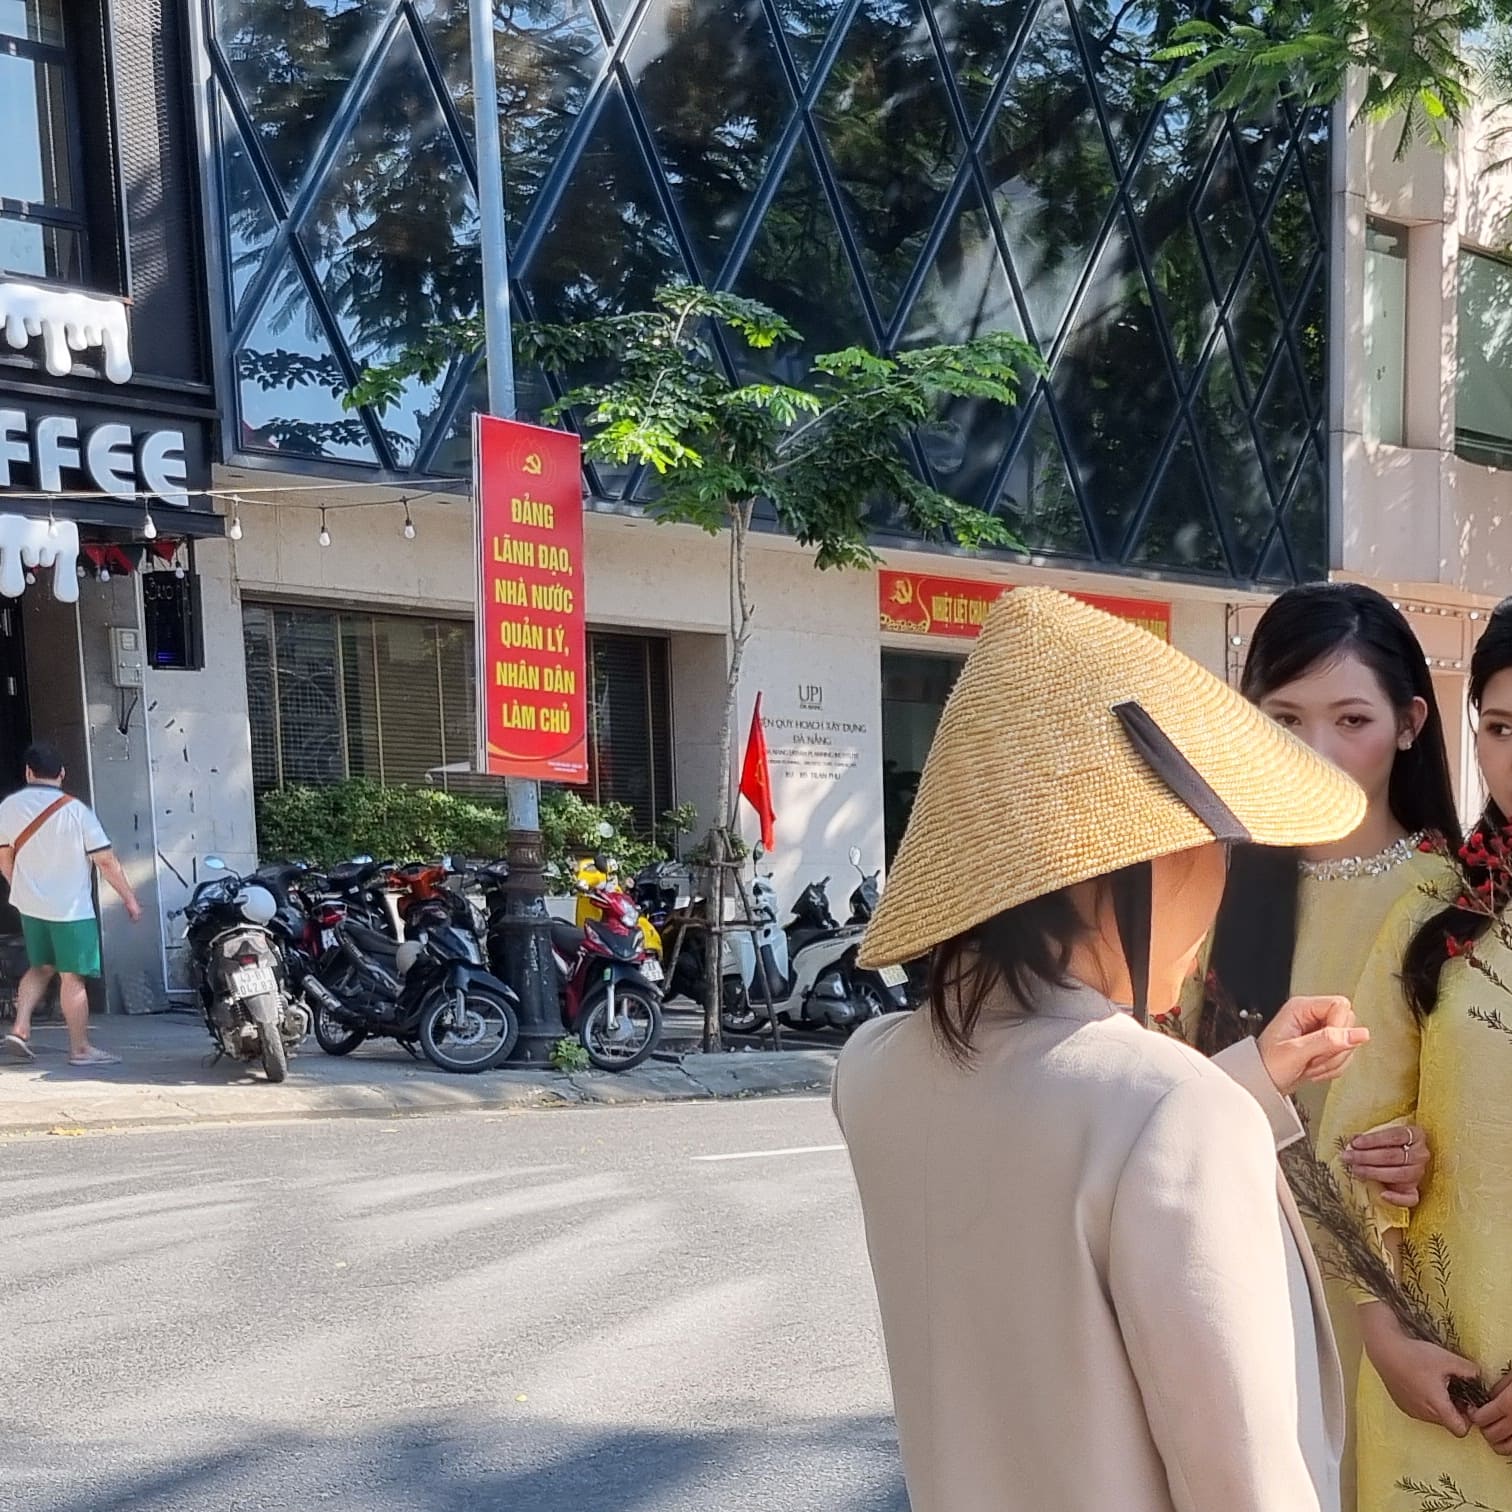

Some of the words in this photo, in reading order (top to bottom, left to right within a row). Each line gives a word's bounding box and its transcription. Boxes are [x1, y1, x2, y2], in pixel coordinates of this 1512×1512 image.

[511, 492, 554, 529] ĐẢNG
[493, 533, 535, 568] LÃNH
[538, 543, 573, 577] ĐẠO,
[495, 577, 529, 608] NHÀ
[531, 583, 574, 614] NƯỚC
[500, 616, 544, 650] QUẢN
[547, 624, 570, 657] LÝ,
[496, 660, 540, 691] NHÂN
[543, 664, 576, 695] DÂN
[502, 699, 536, 731] LÀM
[540, 701, 571, 734] CHỦ
